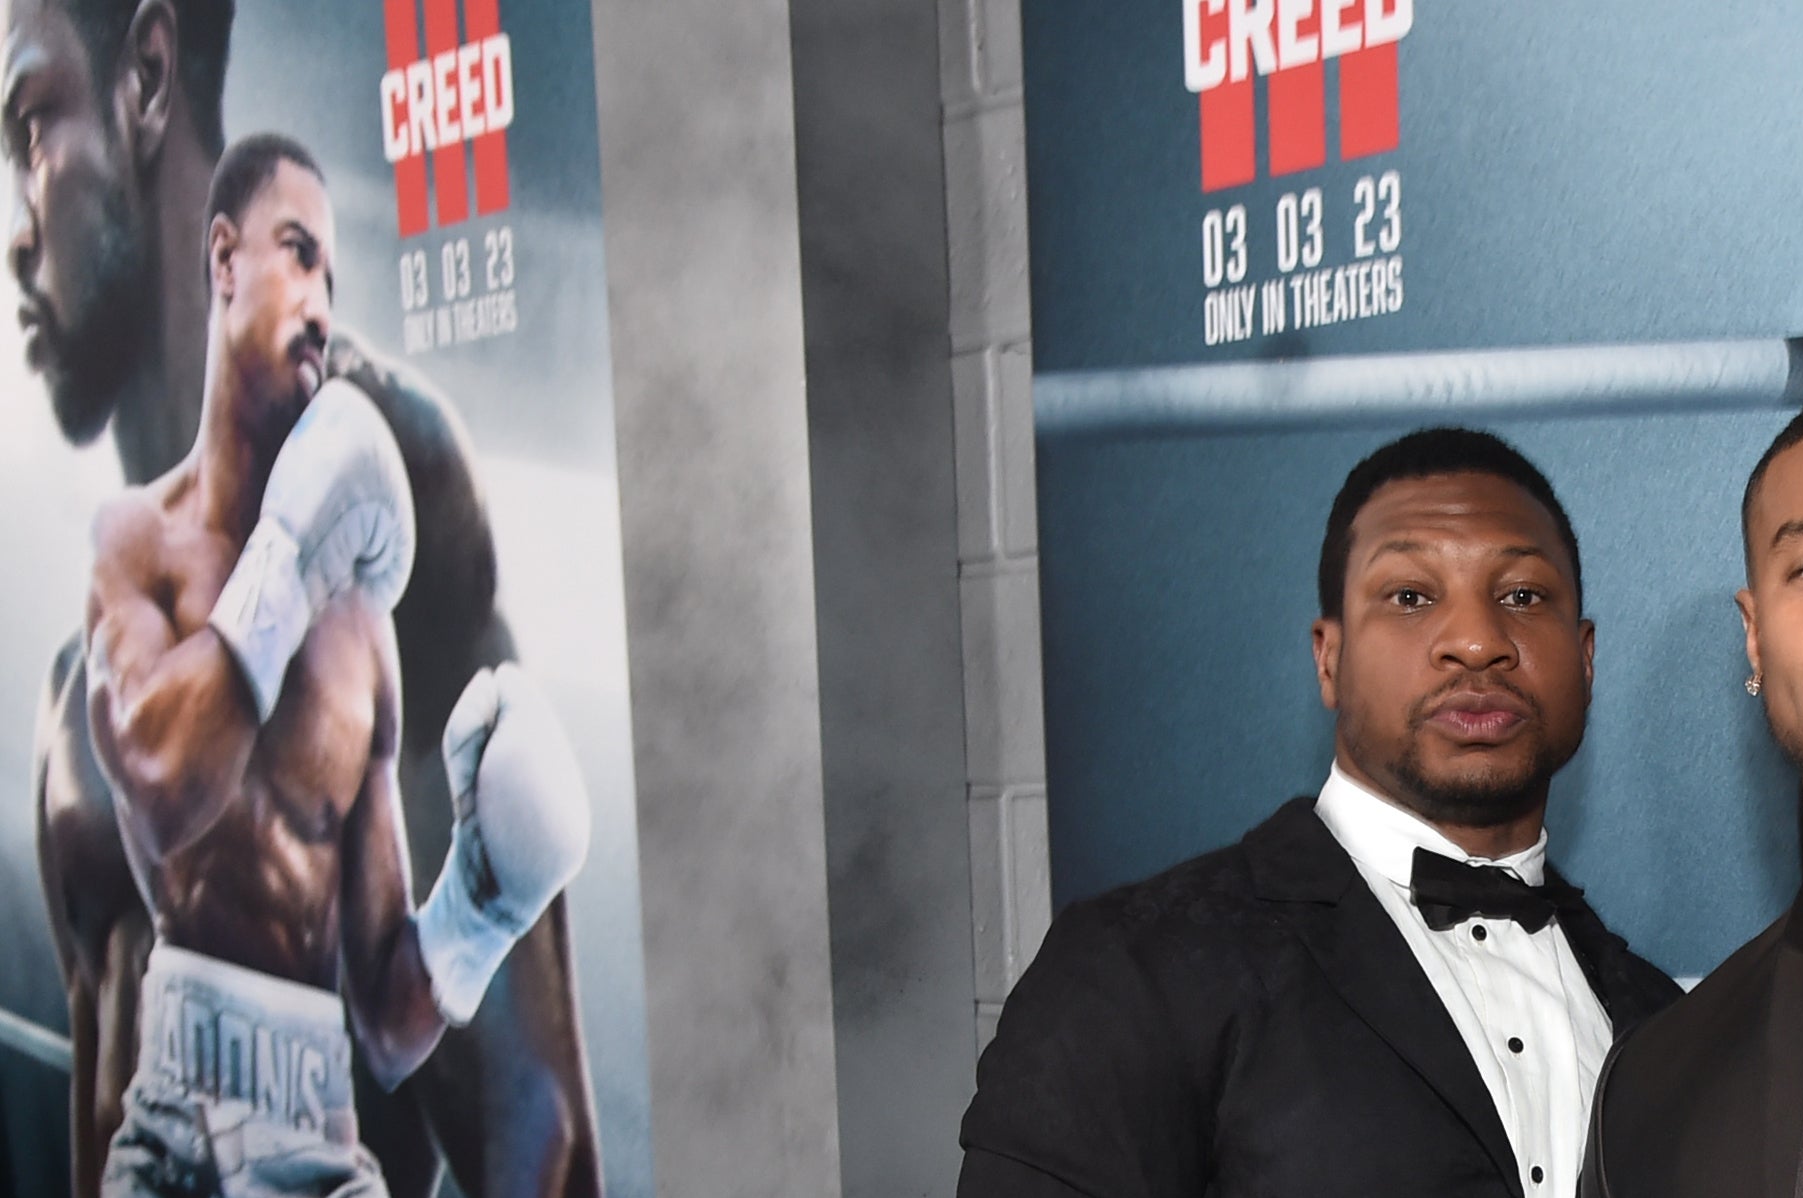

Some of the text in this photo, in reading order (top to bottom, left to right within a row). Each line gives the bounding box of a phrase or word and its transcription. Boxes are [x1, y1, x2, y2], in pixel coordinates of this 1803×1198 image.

[380, 32, 514, 163] CREED
[400, 225, 515, 311] 03 03 23
[1202, 169, 1402, 288] 03 03 23
[404, 287, 518, 355] ONLY IN THEATERS
[1204, 254, 1404, 346] ONLY IN THEATERS
